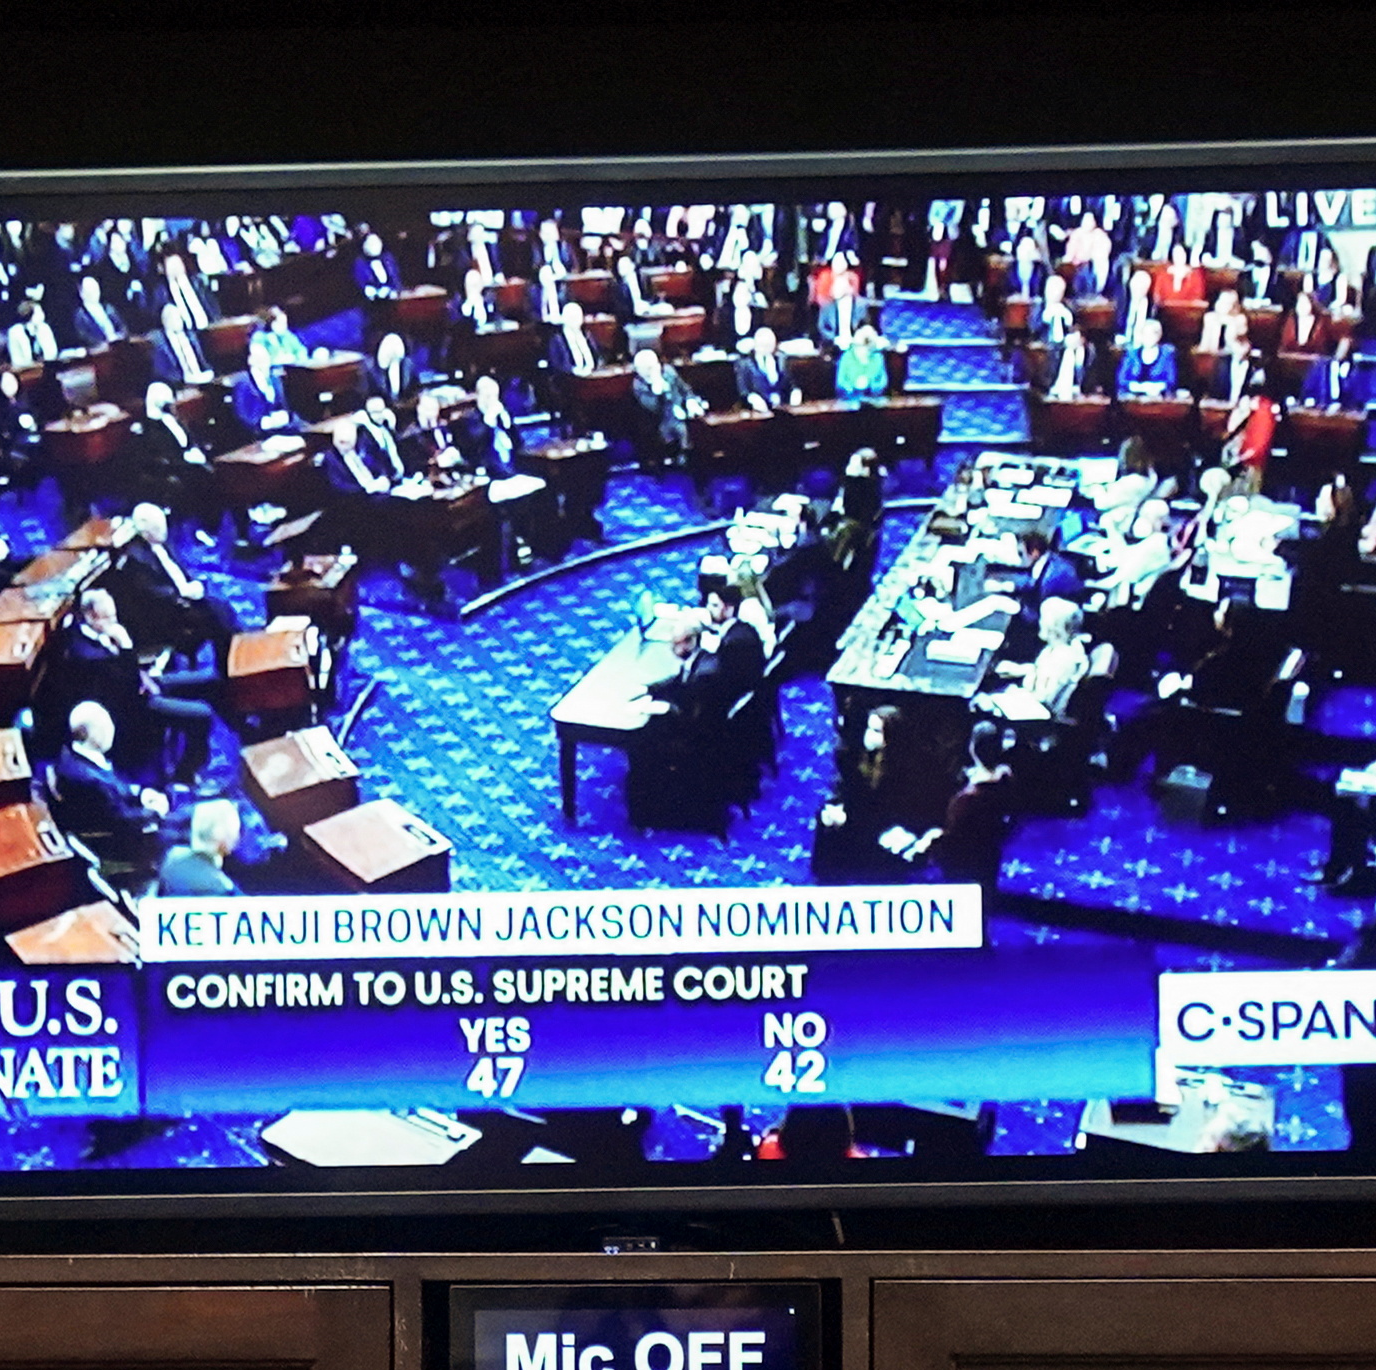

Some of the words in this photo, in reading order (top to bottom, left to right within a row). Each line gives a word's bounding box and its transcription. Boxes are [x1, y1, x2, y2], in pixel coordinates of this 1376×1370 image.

[158, 910, 320, 946] KETANJI
[334, 907, 482, 944] BROWN
[496, 903, 683, 940] JACKSON
[698, 899, 954, 937] NOMINATION
[167, 972, 343, 1008] CONFIRM
[353, 971, 406, 1006] TO
[415, 970, 484, 1004] U.S.
[492, 967, 665, 1003] SUPREME
[673, 964, 808, 1000] COURT
[460, 1017, 531, 1053] YES
[764, 1012, 827, 1048] NO
[466, 1057, 524, 1098] 47
[764, 1050, 826, 1093] 42
